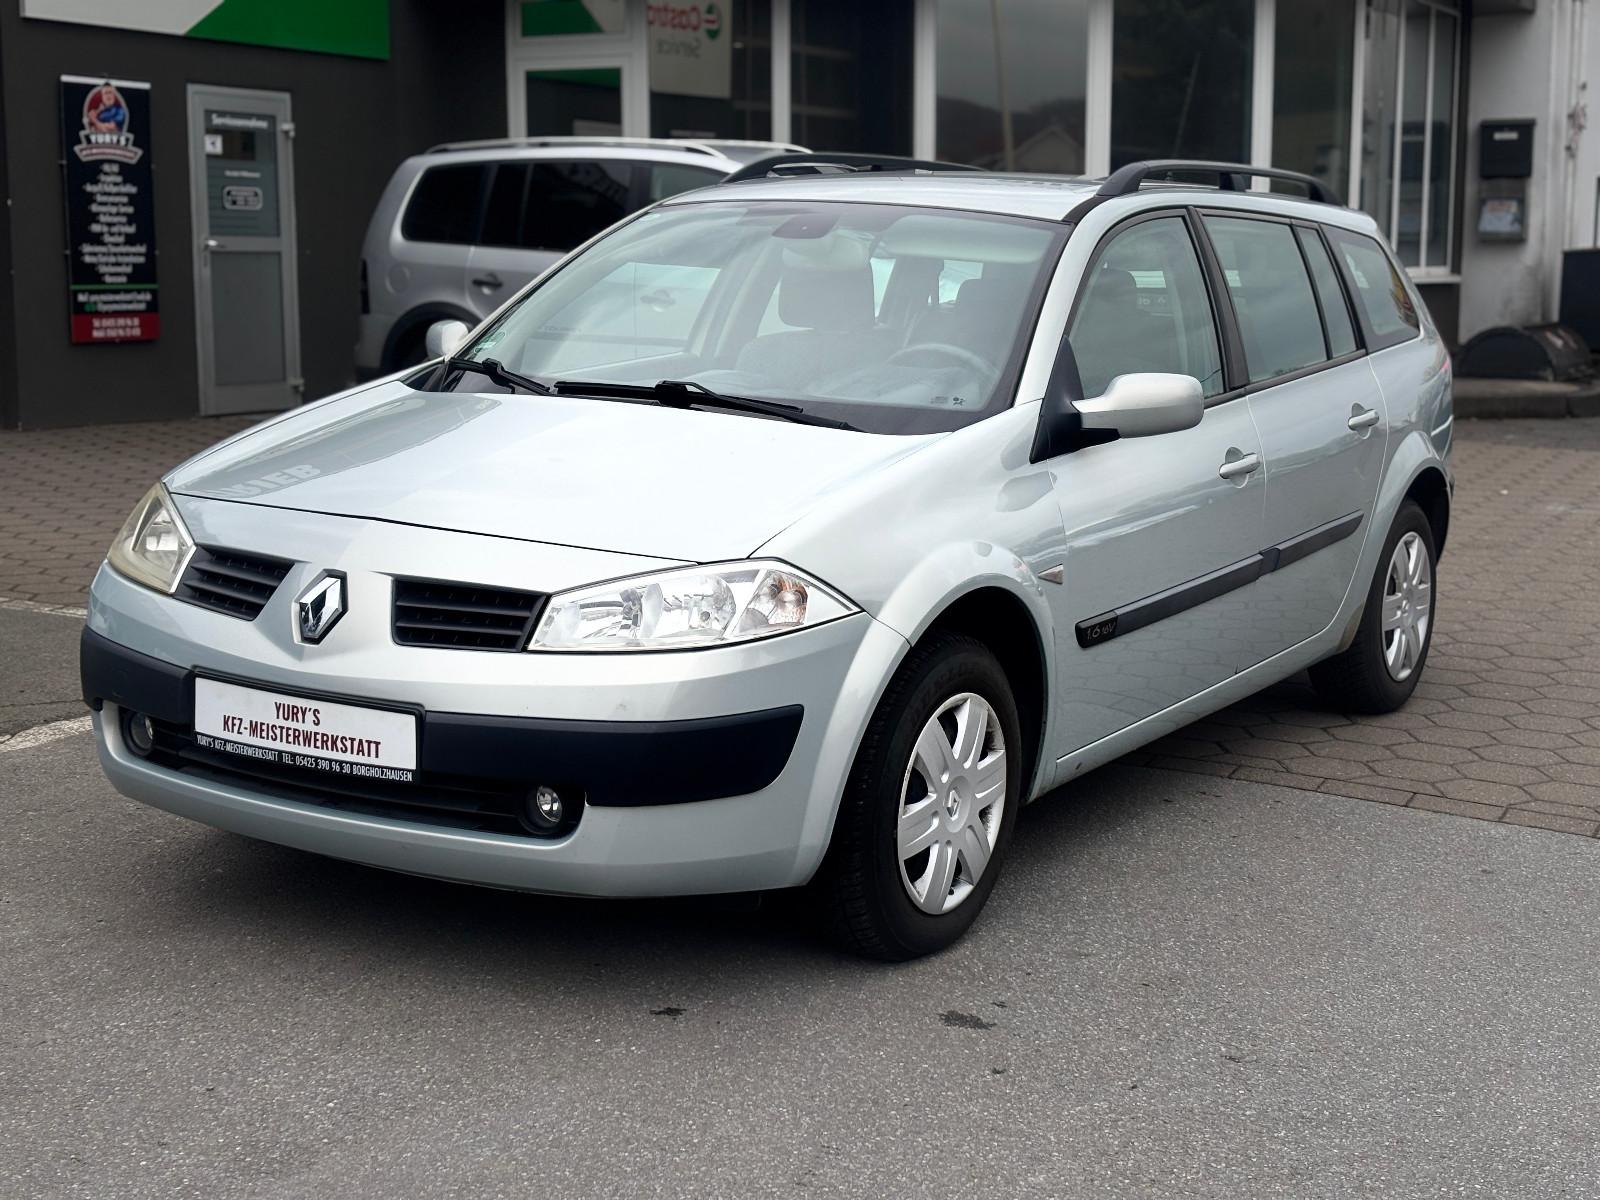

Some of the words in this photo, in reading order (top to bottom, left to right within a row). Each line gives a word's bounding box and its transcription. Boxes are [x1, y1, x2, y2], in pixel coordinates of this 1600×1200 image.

[196, 734, 214, 748] YURY'S
[214, 737, 278, 761] KFZ-MEISTERWERKSTATT
[281, 753, 294, 765] TEL:
[295, 755, 316, 768] 05425
[317, 758, 330, 771] 390
[331, 760, 341, 772] 96
[342, 762, 351, 774] 30
[352, 764, 413, 782] BORGHOLZHAUSEN
[223, 714, 381, 759] KFZ-MEISTERWERKSTATT
